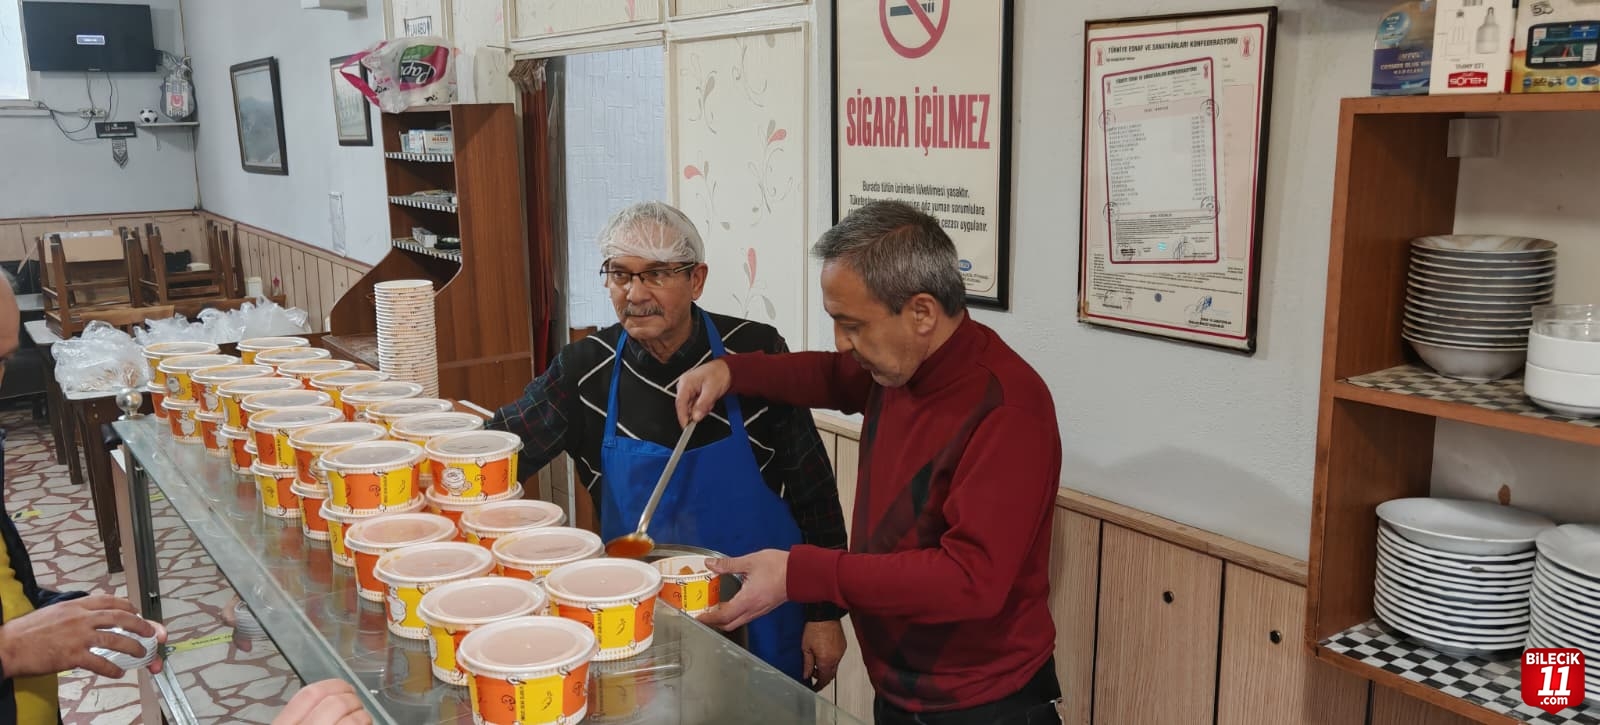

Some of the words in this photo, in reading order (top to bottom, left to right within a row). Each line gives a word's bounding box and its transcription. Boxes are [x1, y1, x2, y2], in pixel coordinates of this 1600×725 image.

[846, 88, 909, 148] SİGARA
[914, 86, 990, 156] İÇİLMEZ
[862, 181, 880, 192] Burada
[895, 183, 915, 194] ürünleri
[932, 203, 950, 216] yuman
[951, 202, 985, 215] sorumlulara
[941, 219, 959, 229] cezası
[960, 220, 988, 232] uygulanır.
